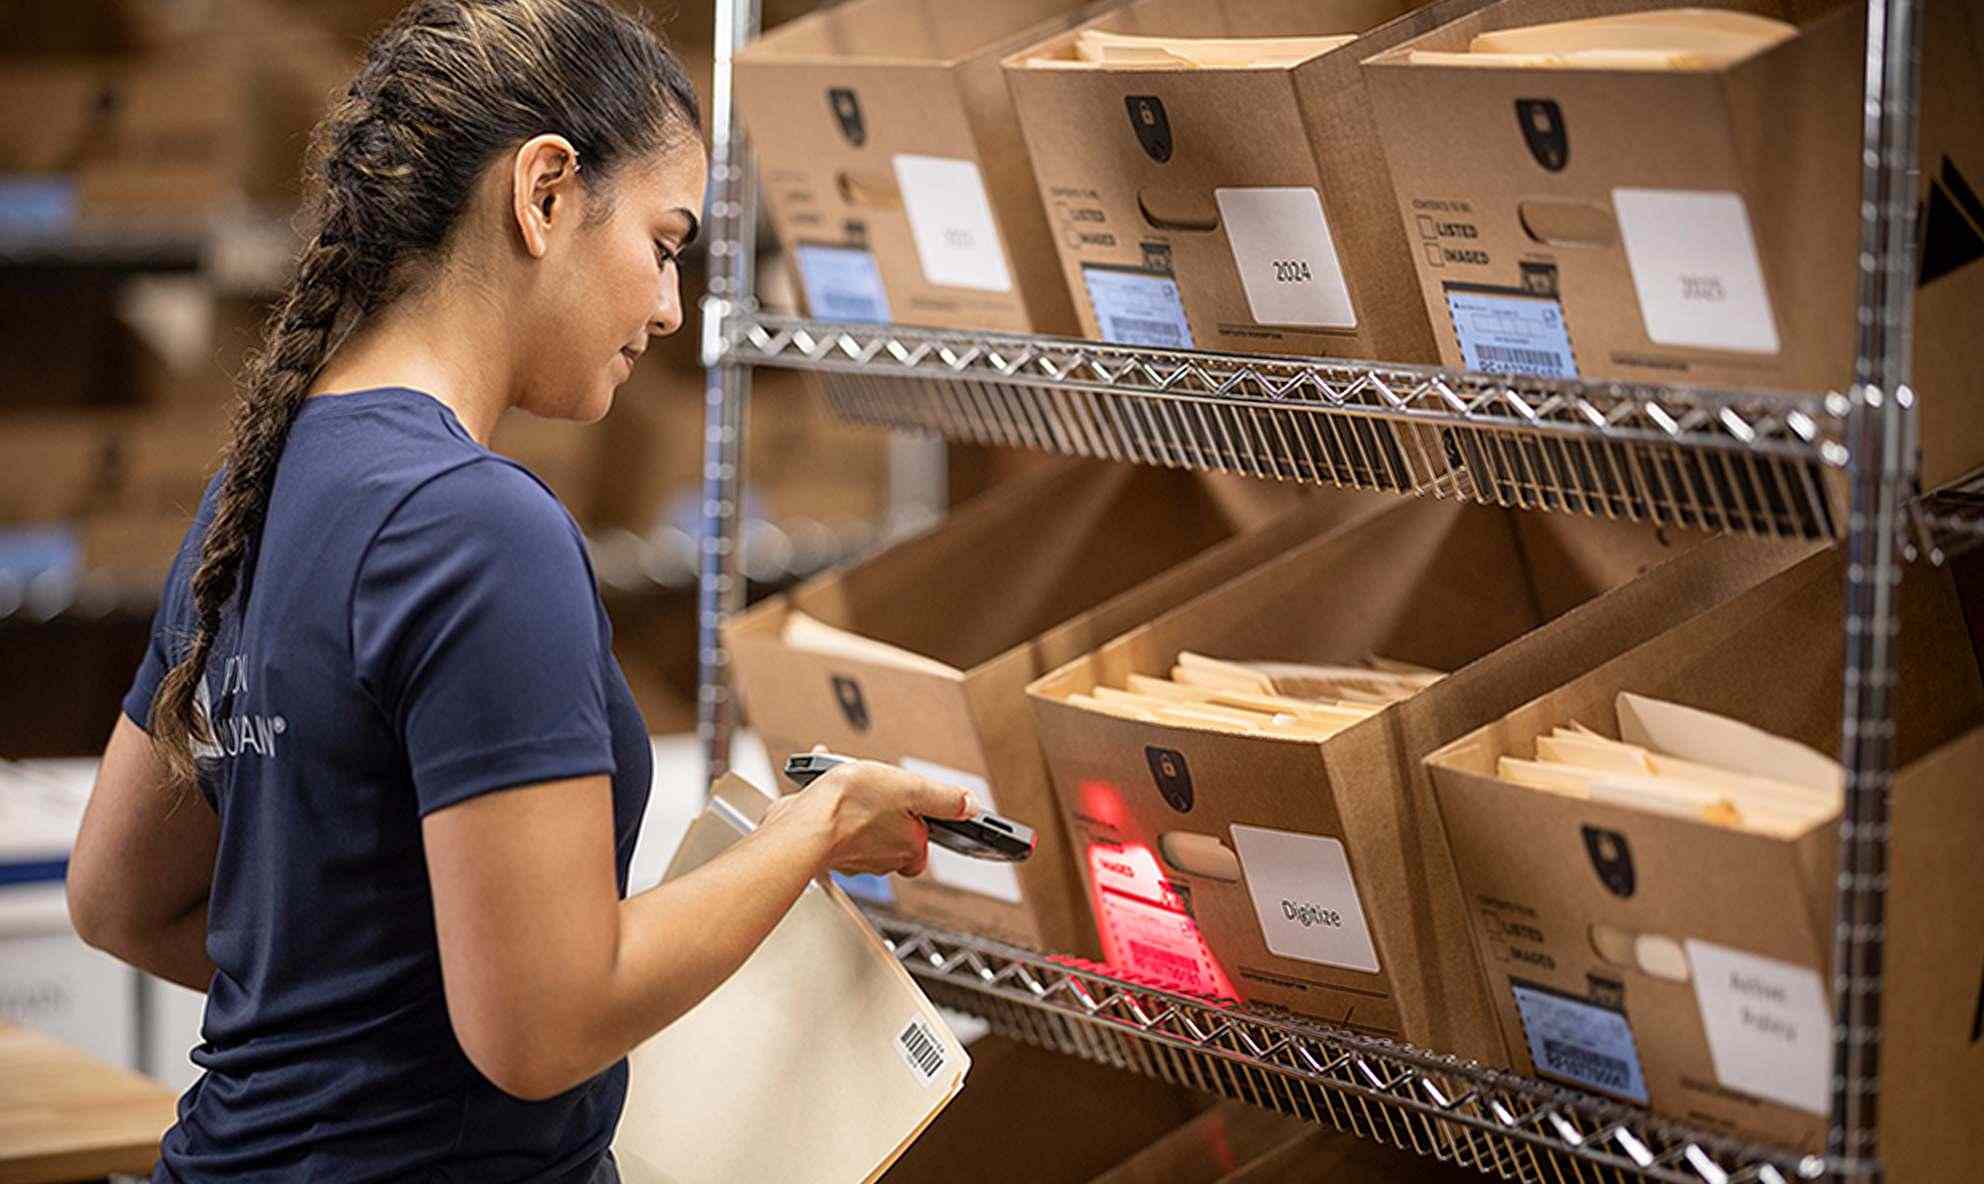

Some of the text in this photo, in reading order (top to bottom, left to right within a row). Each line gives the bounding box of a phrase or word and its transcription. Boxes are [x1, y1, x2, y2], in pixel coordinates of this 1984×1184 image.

[1436, 222, 1478, 239] LISTED
[1273, 261, 1312, 283] 2024
[1281, 899, 1342, 928] Digitize
